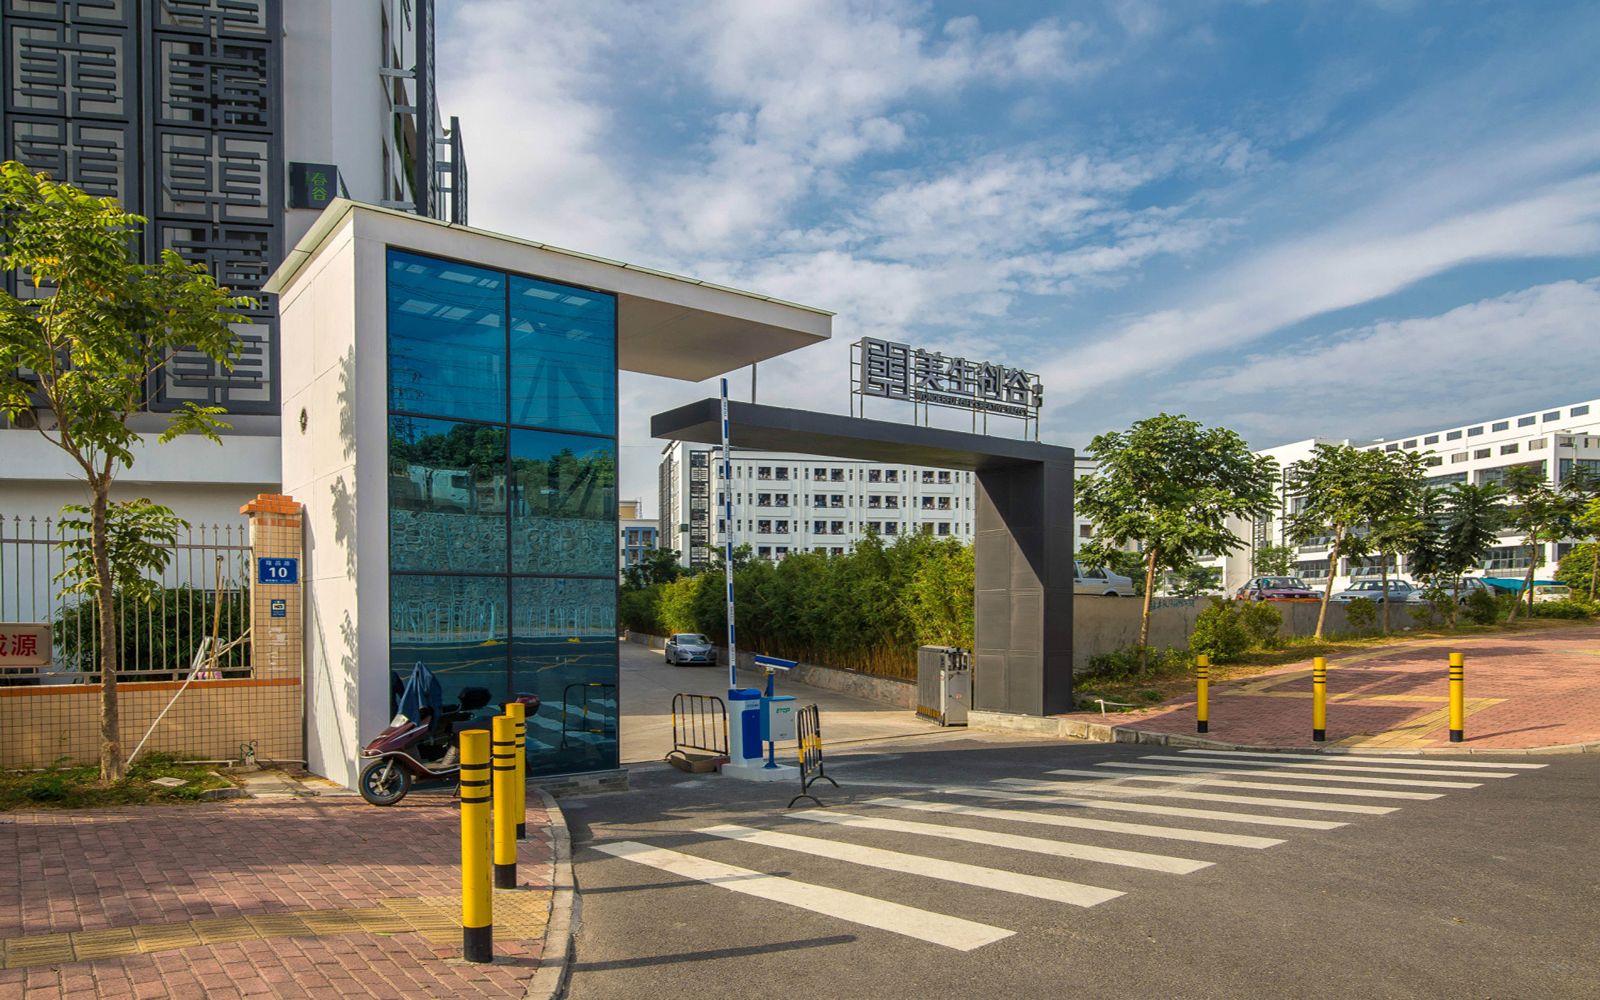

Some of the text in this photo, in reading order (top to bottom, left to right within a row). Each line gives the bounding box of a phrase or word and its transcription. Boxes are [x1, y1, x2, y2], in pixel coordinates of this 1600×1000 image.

[917, 348, 1031, 404] 美生创谷
[269, 567, 288, 578] 10
